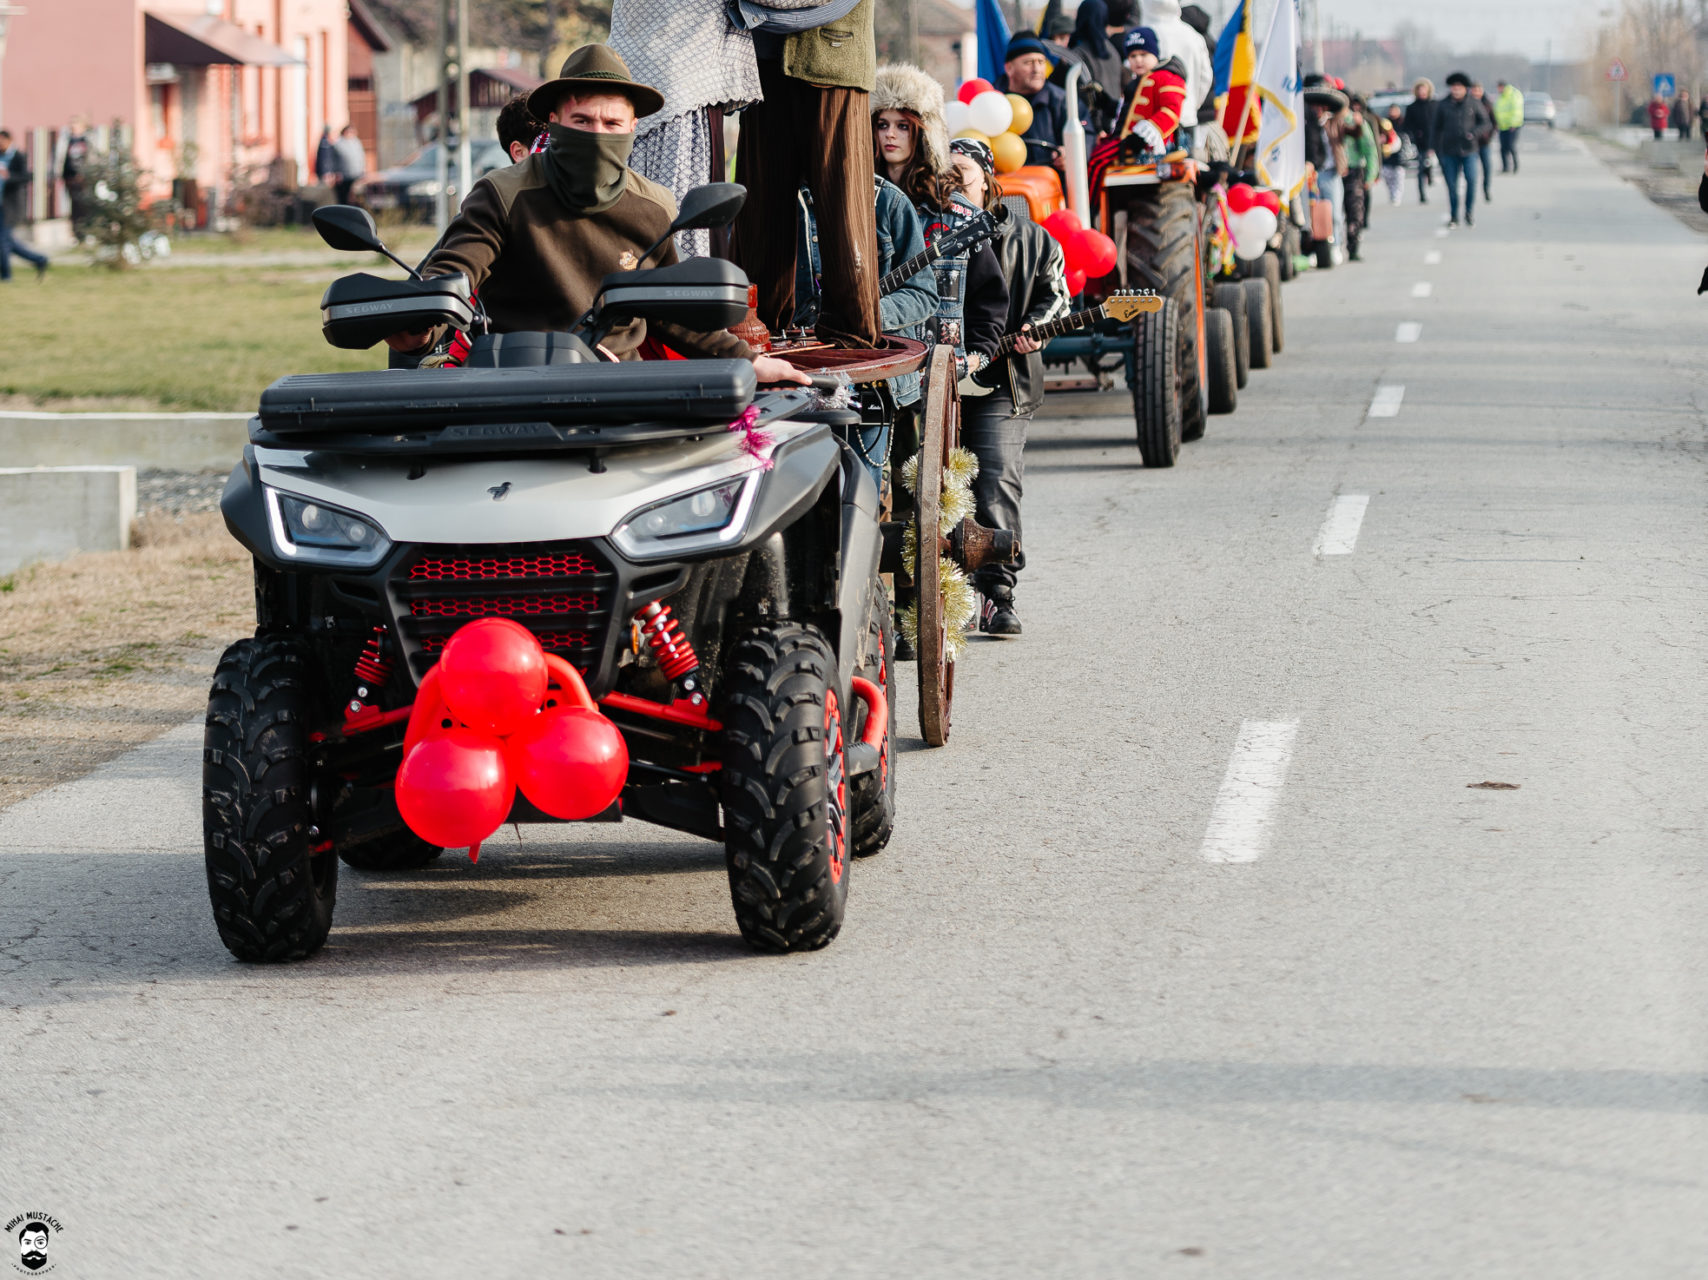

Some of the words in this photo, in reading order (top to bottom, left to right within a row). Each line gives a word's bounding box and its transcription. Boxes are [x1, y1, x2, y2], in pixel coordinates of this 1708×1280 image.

[665, 289, 716, 297] SEGWAY
[345, 303, 393, 314] SEGWAY
[449, 424, 541, 438] SEGWAY
